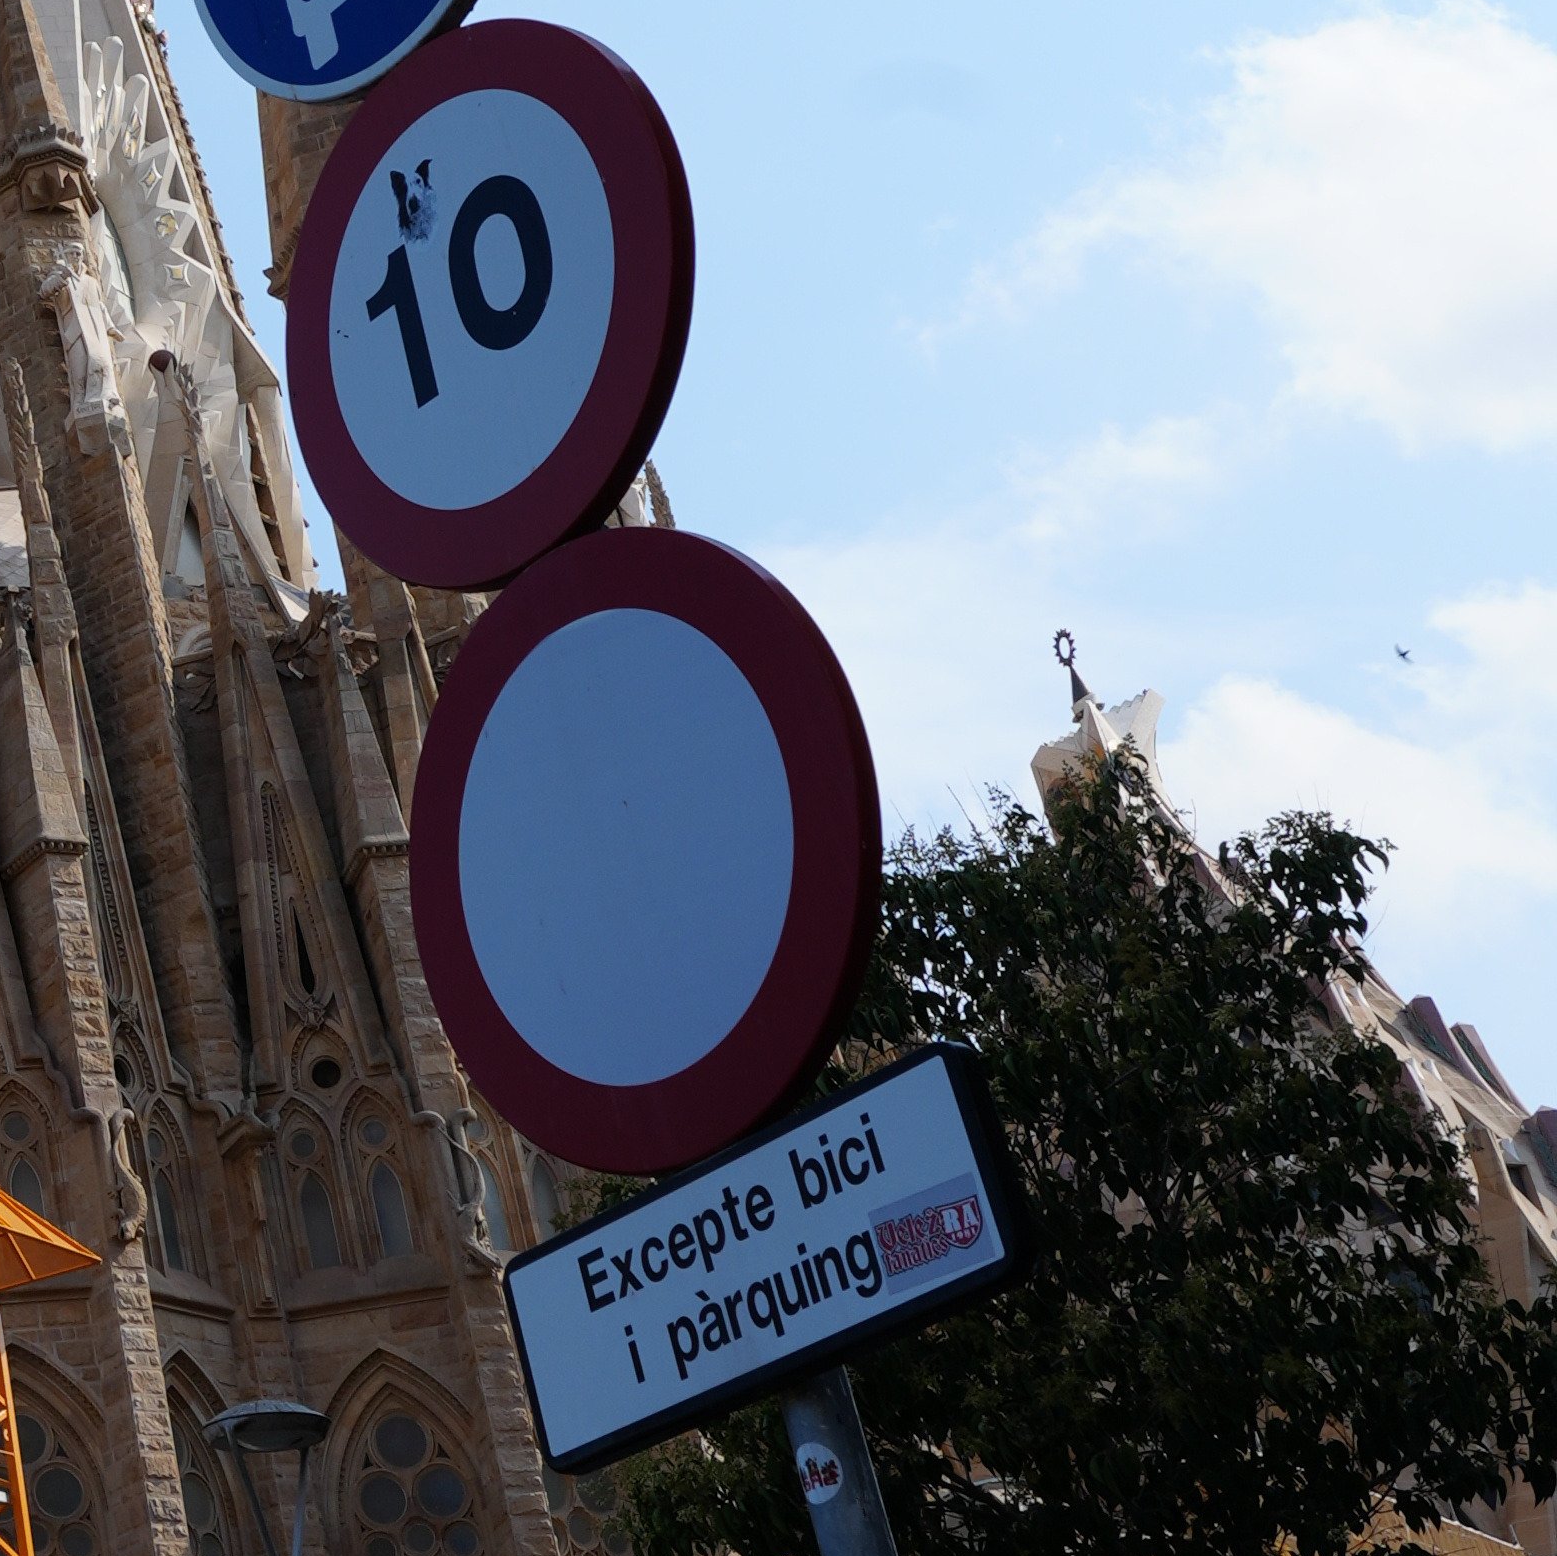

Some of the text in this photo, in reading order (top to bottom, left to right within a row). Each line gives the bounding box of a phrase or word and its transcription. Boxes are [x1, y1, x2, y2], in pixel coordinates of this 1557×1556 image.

[365, 174, 555, 409] 10
[577, 1113, 887, 1312] Excepte bici
[624, 1230, 884, 1383] i pàrquing
